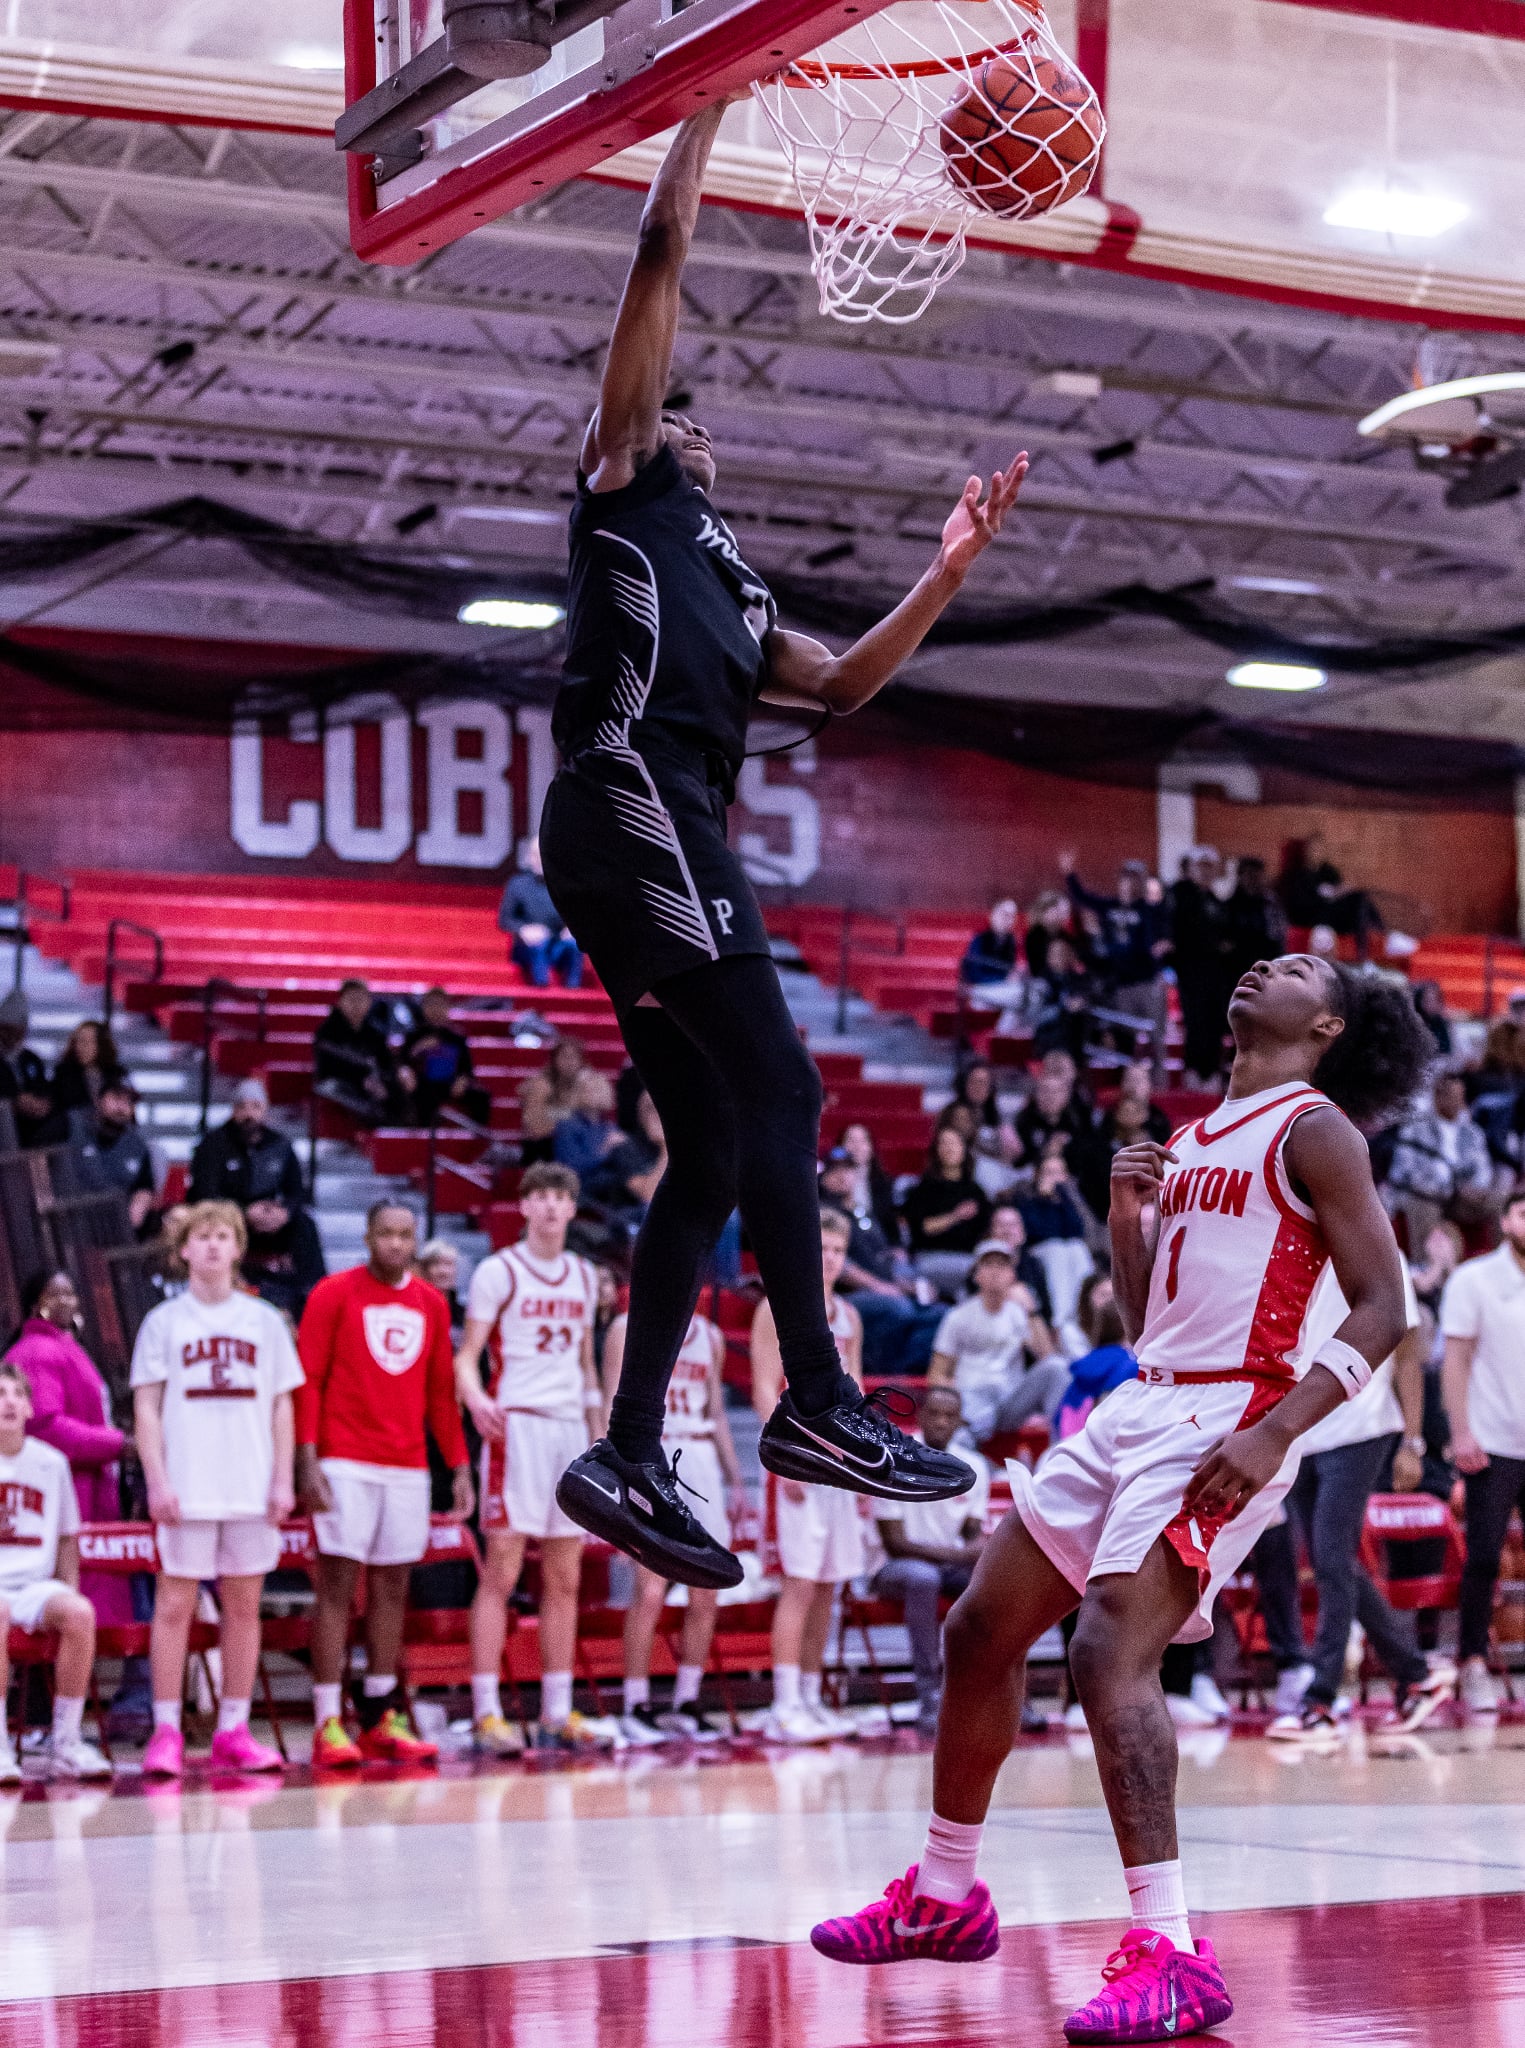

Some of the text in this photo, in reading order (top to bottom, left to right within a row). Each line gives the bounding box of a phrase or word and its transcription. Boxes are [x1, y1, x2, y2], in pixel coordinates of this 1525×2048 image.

[230, 683, 821, 886] COBS
[711, 898, 734, 935] P
[1160, 1166, 1253, 1217] ANTON
[1166, 1226, 1187, 1304] 1
[520, 1298, 584, 1319] CANTON
[182, 1336, 257, 1368] CANTON
[536, 1326, 573, 1354] 23
[79, 1534, 154, 1562] CANTO
